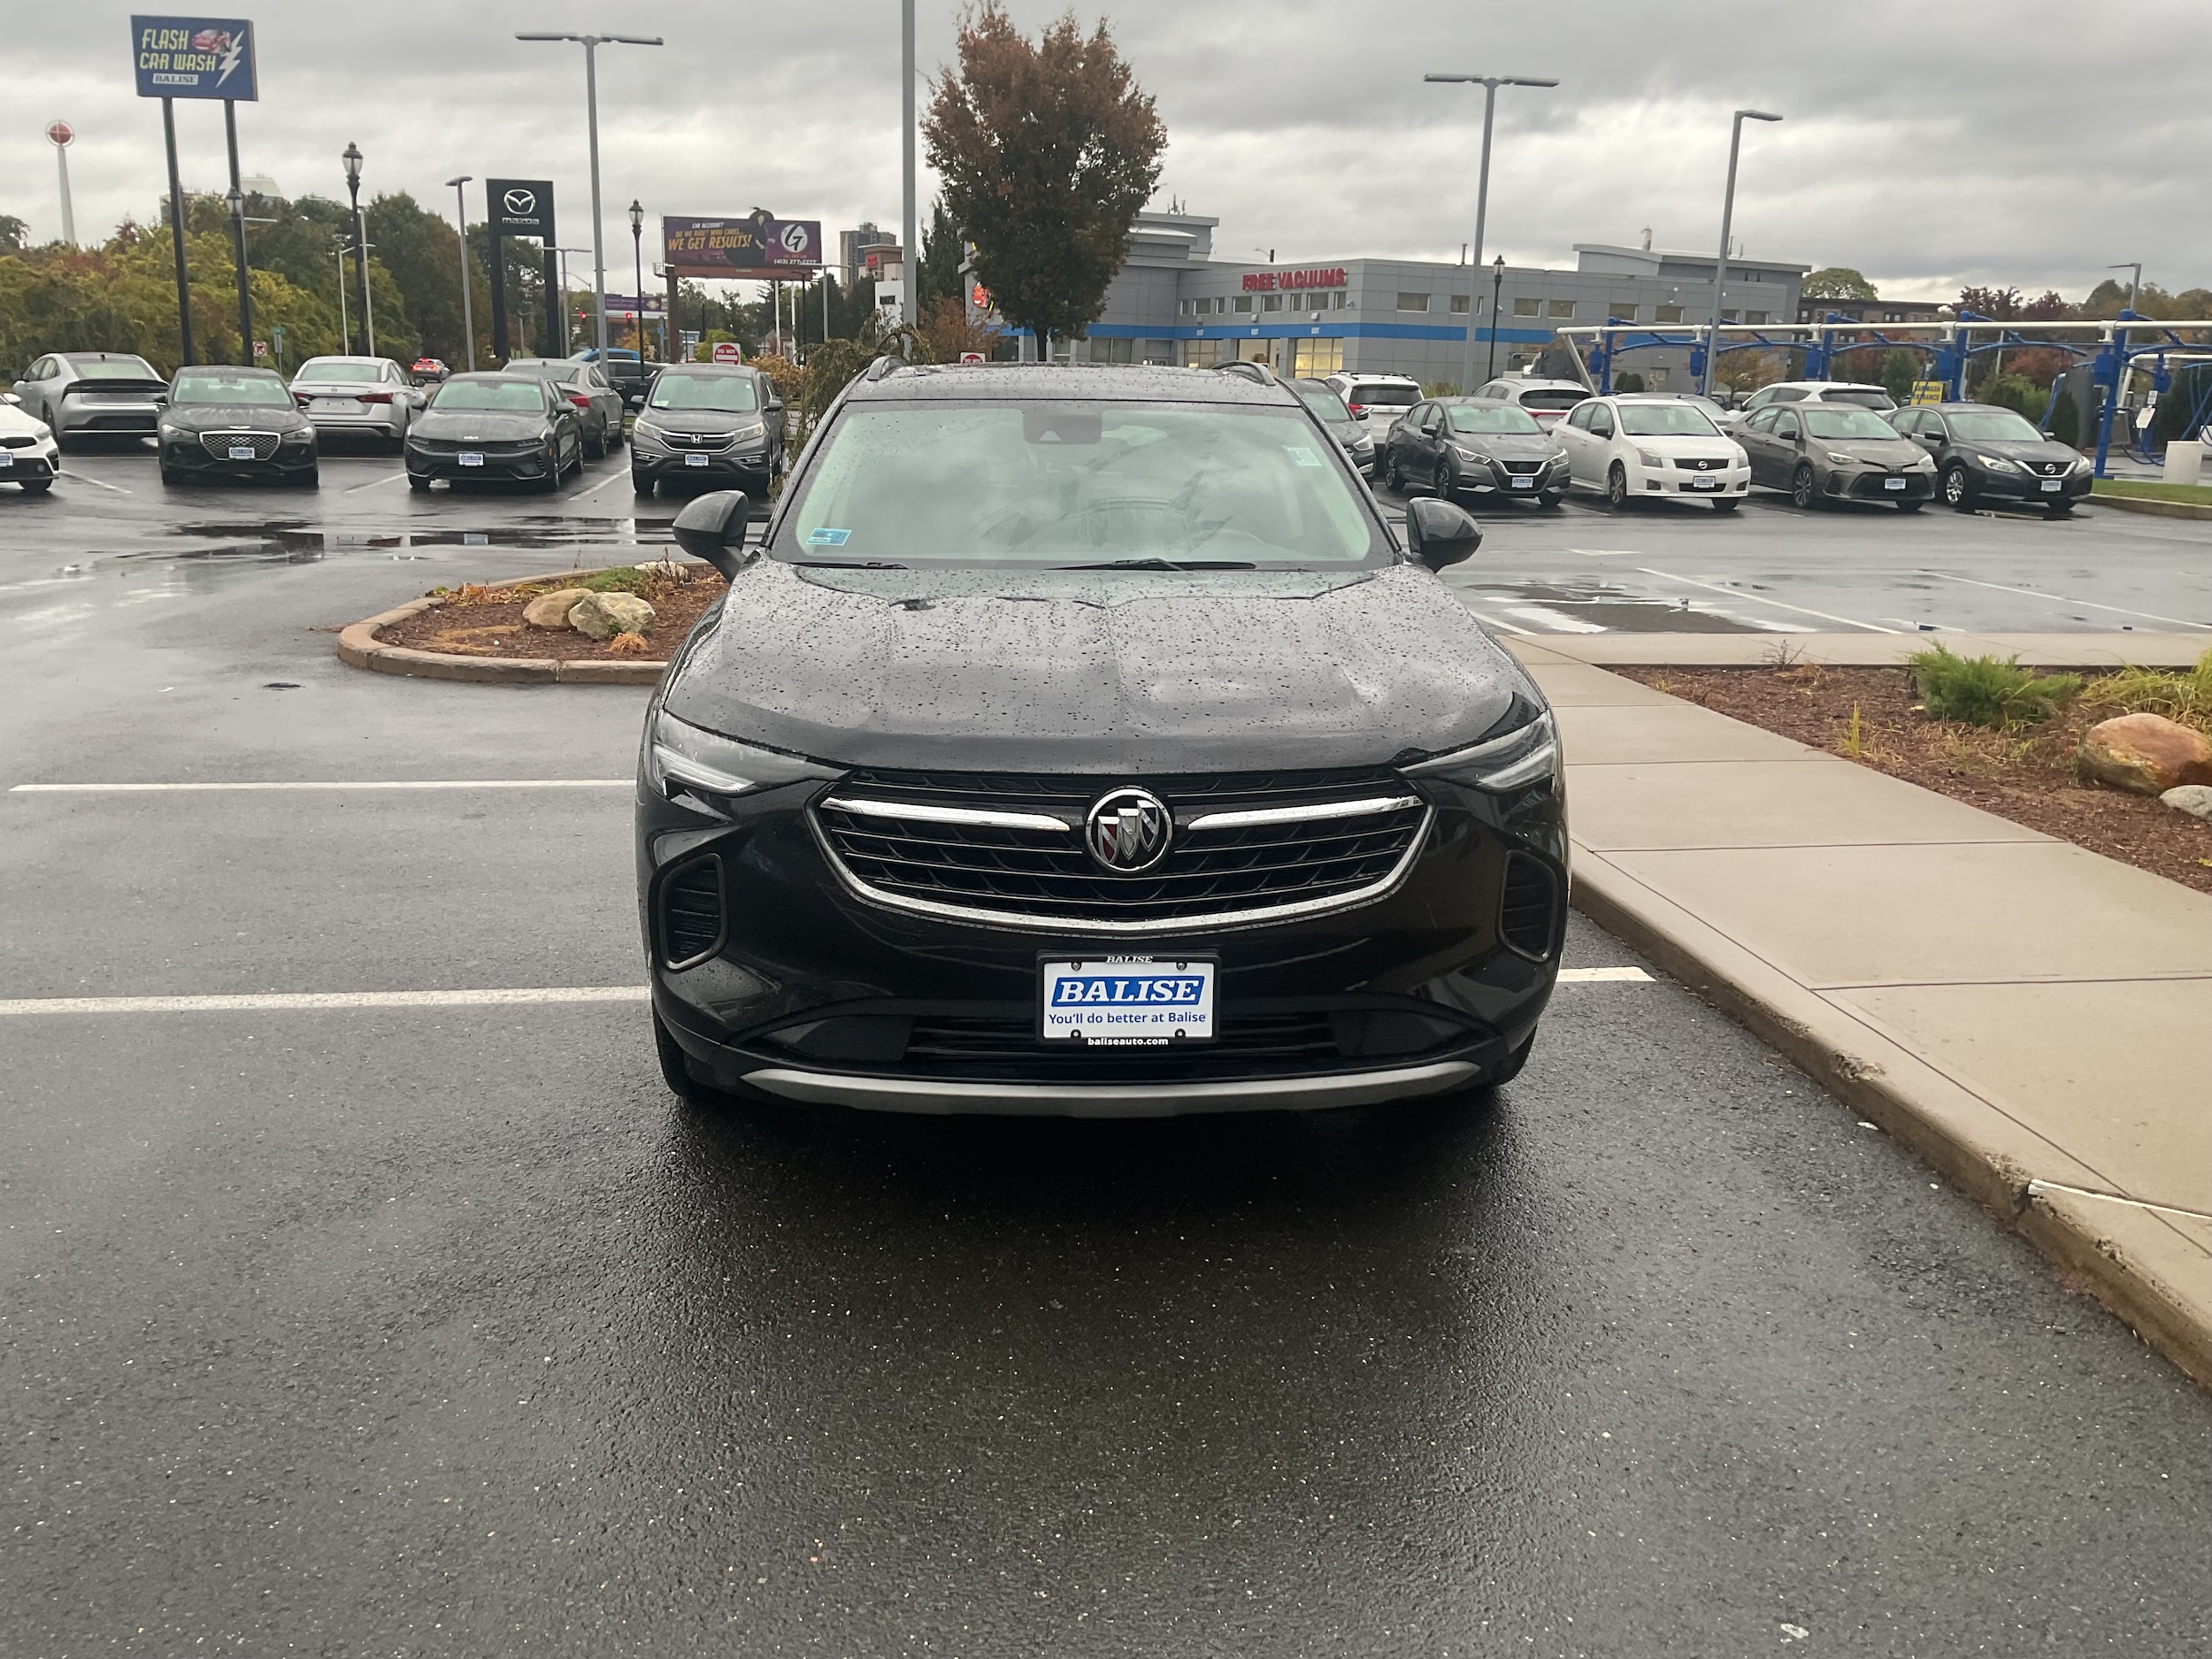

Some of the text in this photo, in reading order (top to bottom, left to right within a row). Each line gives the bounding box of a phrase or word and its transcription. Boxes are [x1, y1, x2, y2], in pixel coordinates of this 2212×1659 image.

[142, 29, 188, 50] FLASH
[140, 52, 216, 71] CAR WASH
[669, 234, 752, 250] WE GET RESULTS!
[1242, 268, 1346, 291] FREE VACUUMS
[1056, 979, 1199, 1002] BALISE
[1048, 1011, 1206, 1024] You'll do better at Balise
[1087, 1037, 1169, 1046] baliseauto.com
